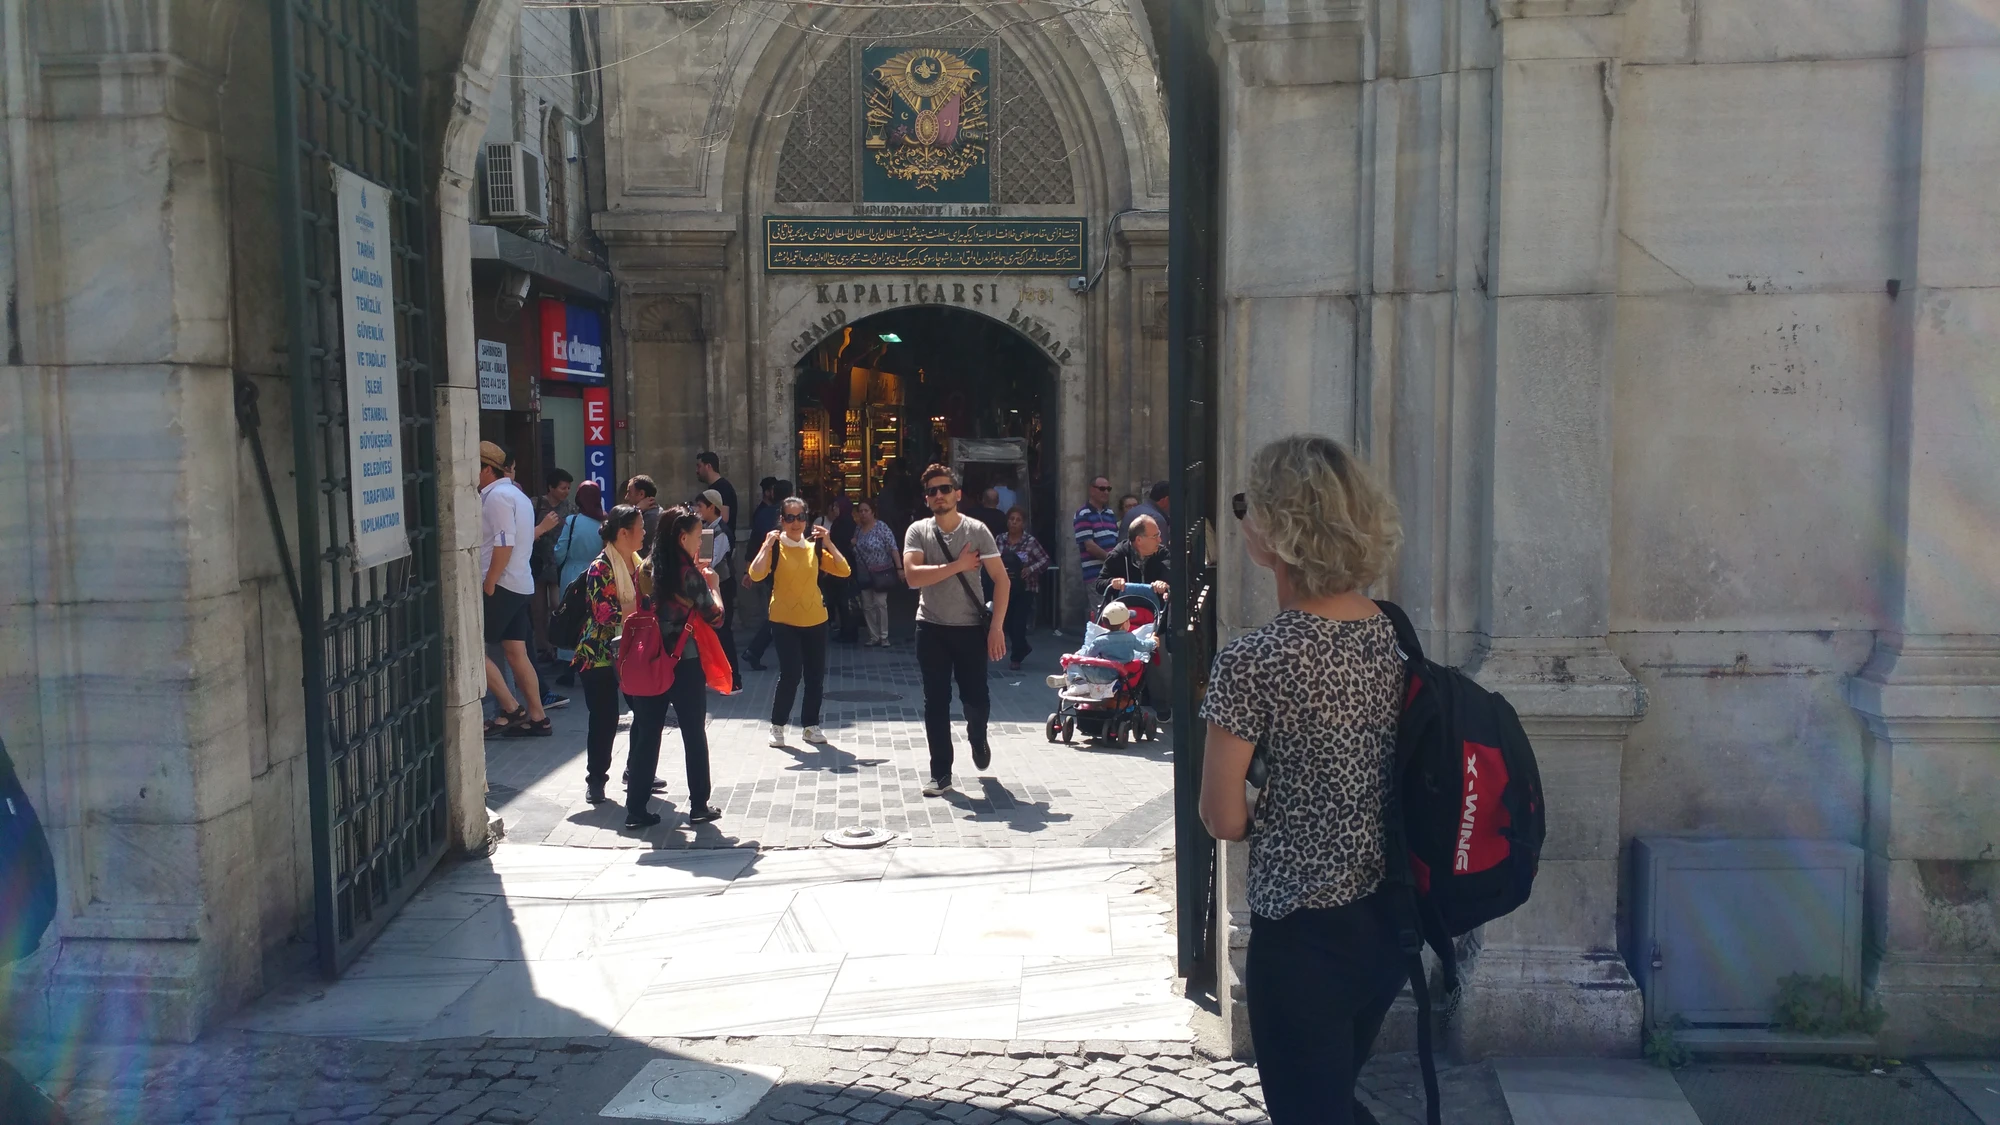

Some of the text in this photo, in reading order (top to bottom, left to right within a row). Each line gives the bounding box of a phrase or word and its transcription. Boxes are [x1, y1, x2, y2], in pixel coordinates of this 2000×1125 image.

[356, 240, 376, 260] TARİHİ
[356, 294, 382, 315] TEMİZLİK
[816, 283, 999, 304] KAPALIÇARŞI
[356, 320, 385, 342] GÜVENLİK
[790, 308, 1072, 366] GRAND BAZAAR
[356, 350, 386, 368] VE TADİLAT
[364, 375, 382, 398] İŞLERİ
[362, 402, 388, 422] İSTANBUL
[360, 429, 393, 452] BÜYÜKŞEHİR
[362, 456, 393, 478] BELEDİYESİ
[362, 486, 396, 505] TARAFINDAN
[360, 512, 400, 535] YAPILMAKTADIR
[1455, 752, 1478, 872] X-WING
